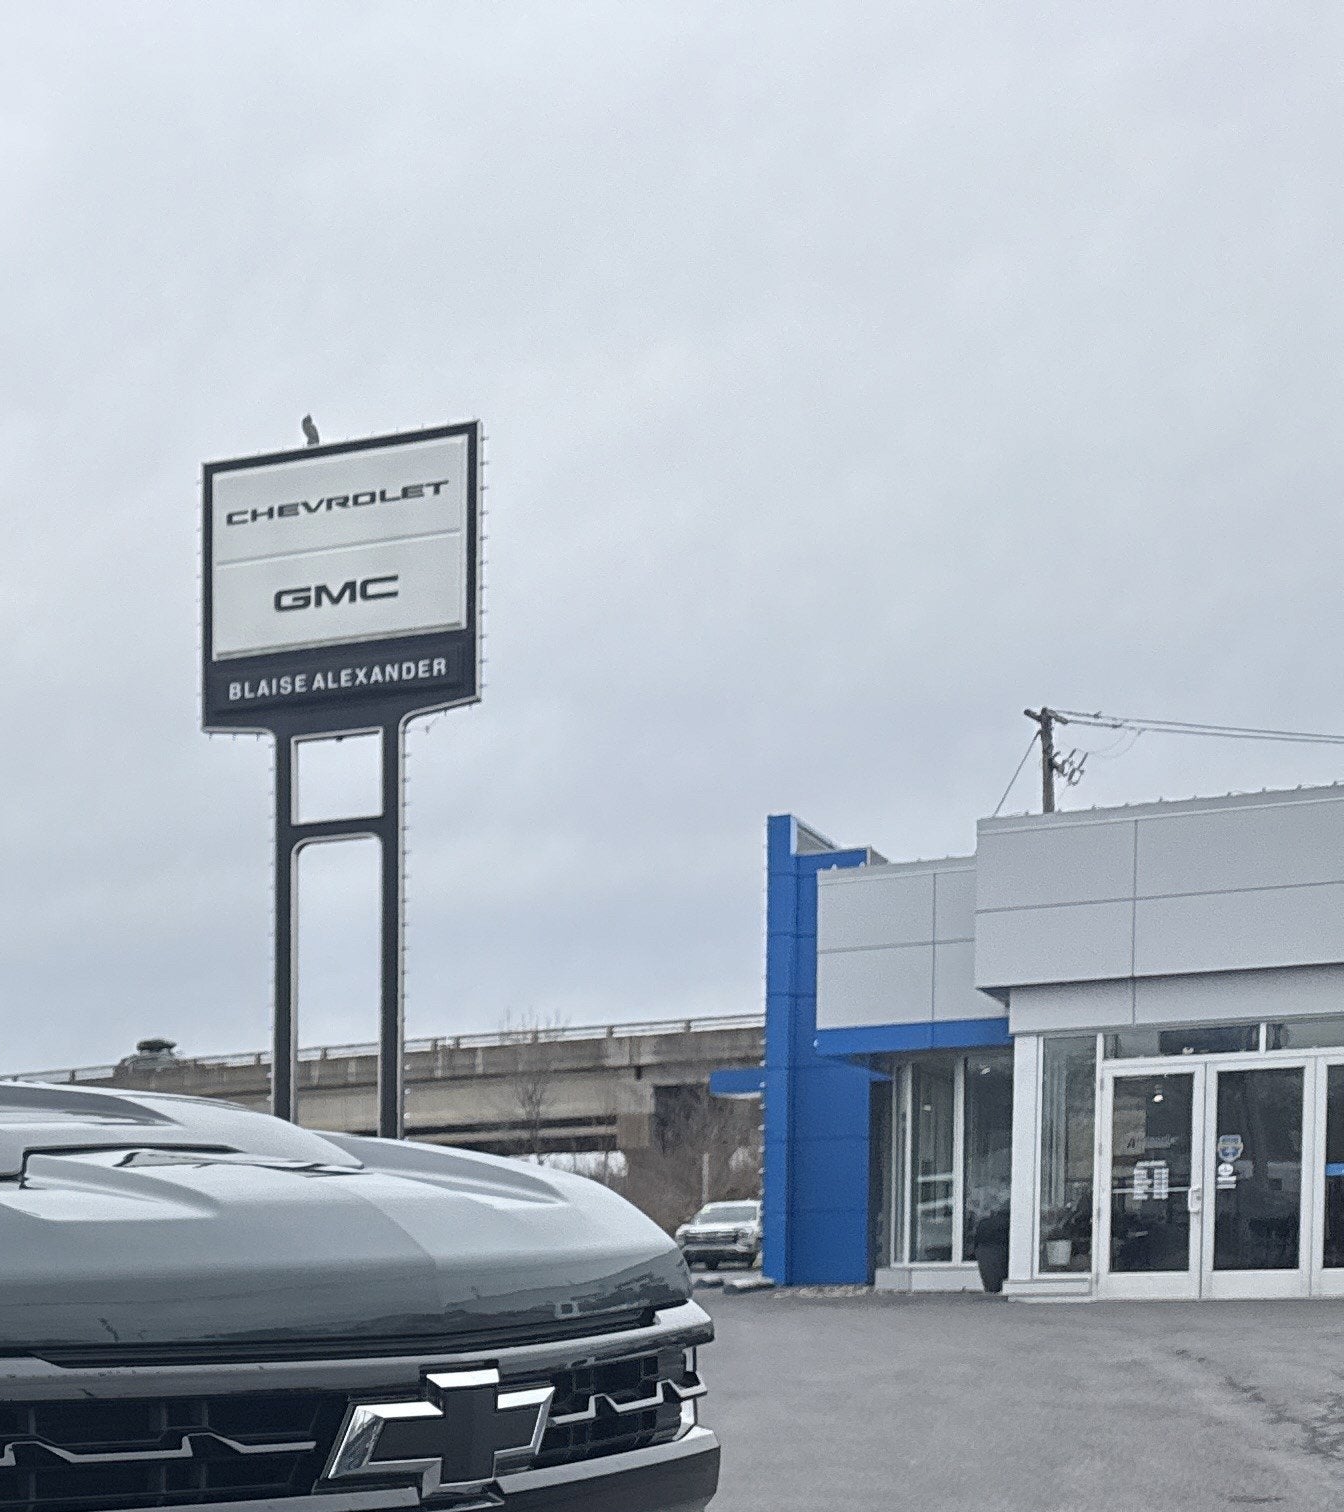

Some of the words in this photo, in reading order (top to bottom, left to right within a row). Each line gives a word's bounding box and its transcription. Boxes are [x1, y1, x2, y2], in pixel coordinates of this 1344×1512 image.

[226, 479, 450, 526] CHEVROLET
[274, 574, 399, 612] GMC
[228, 674, 307, 701] BLAISE
[311, 657, 448, 691] ALEXANDER
